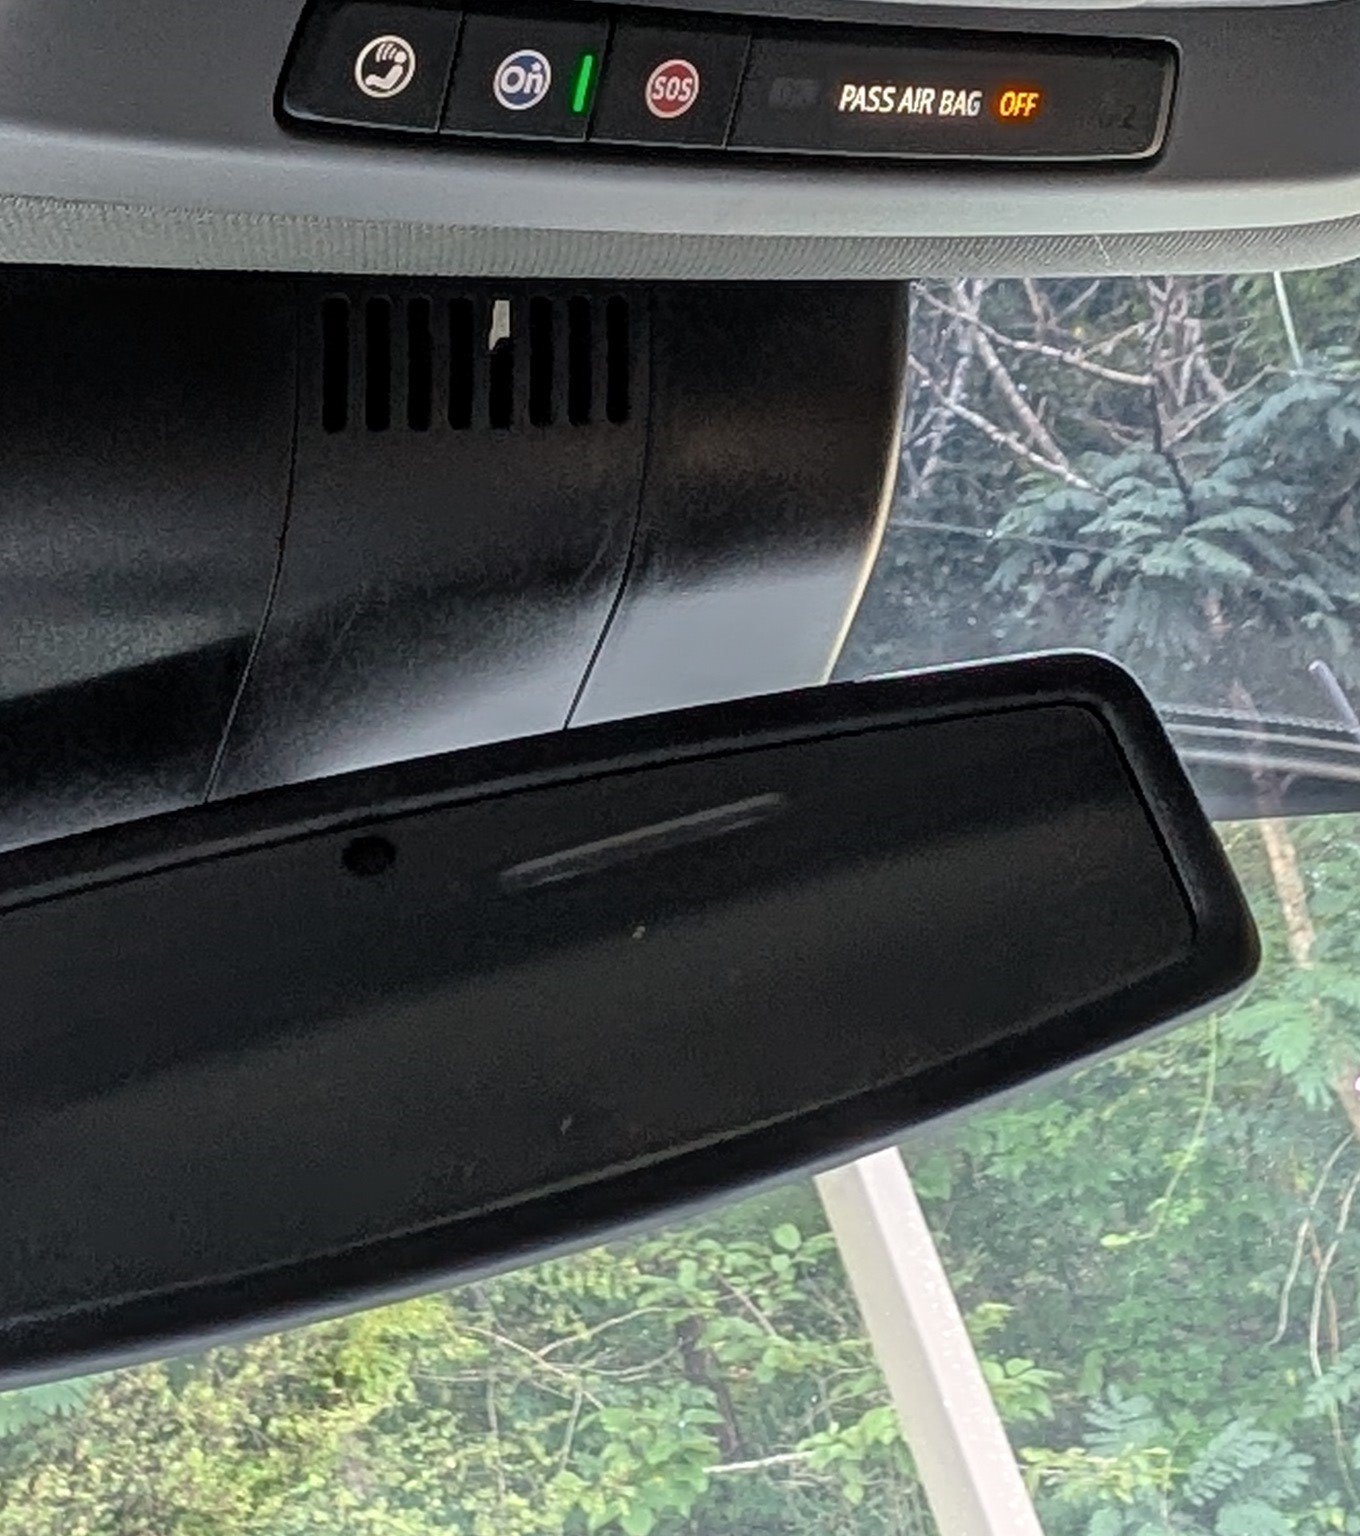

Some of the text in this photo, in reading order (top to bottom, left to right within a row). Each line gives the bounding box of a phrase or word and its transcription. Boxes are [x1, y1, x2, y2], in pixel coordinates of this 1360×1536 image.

[651, 75, 693, 102] SOS
[839, 83, 897, 113] PASS
[897, 86, 936, 115] AIR
[939, 89, 983, 117] BAG
[999, 90, 1040, 117] OFF
